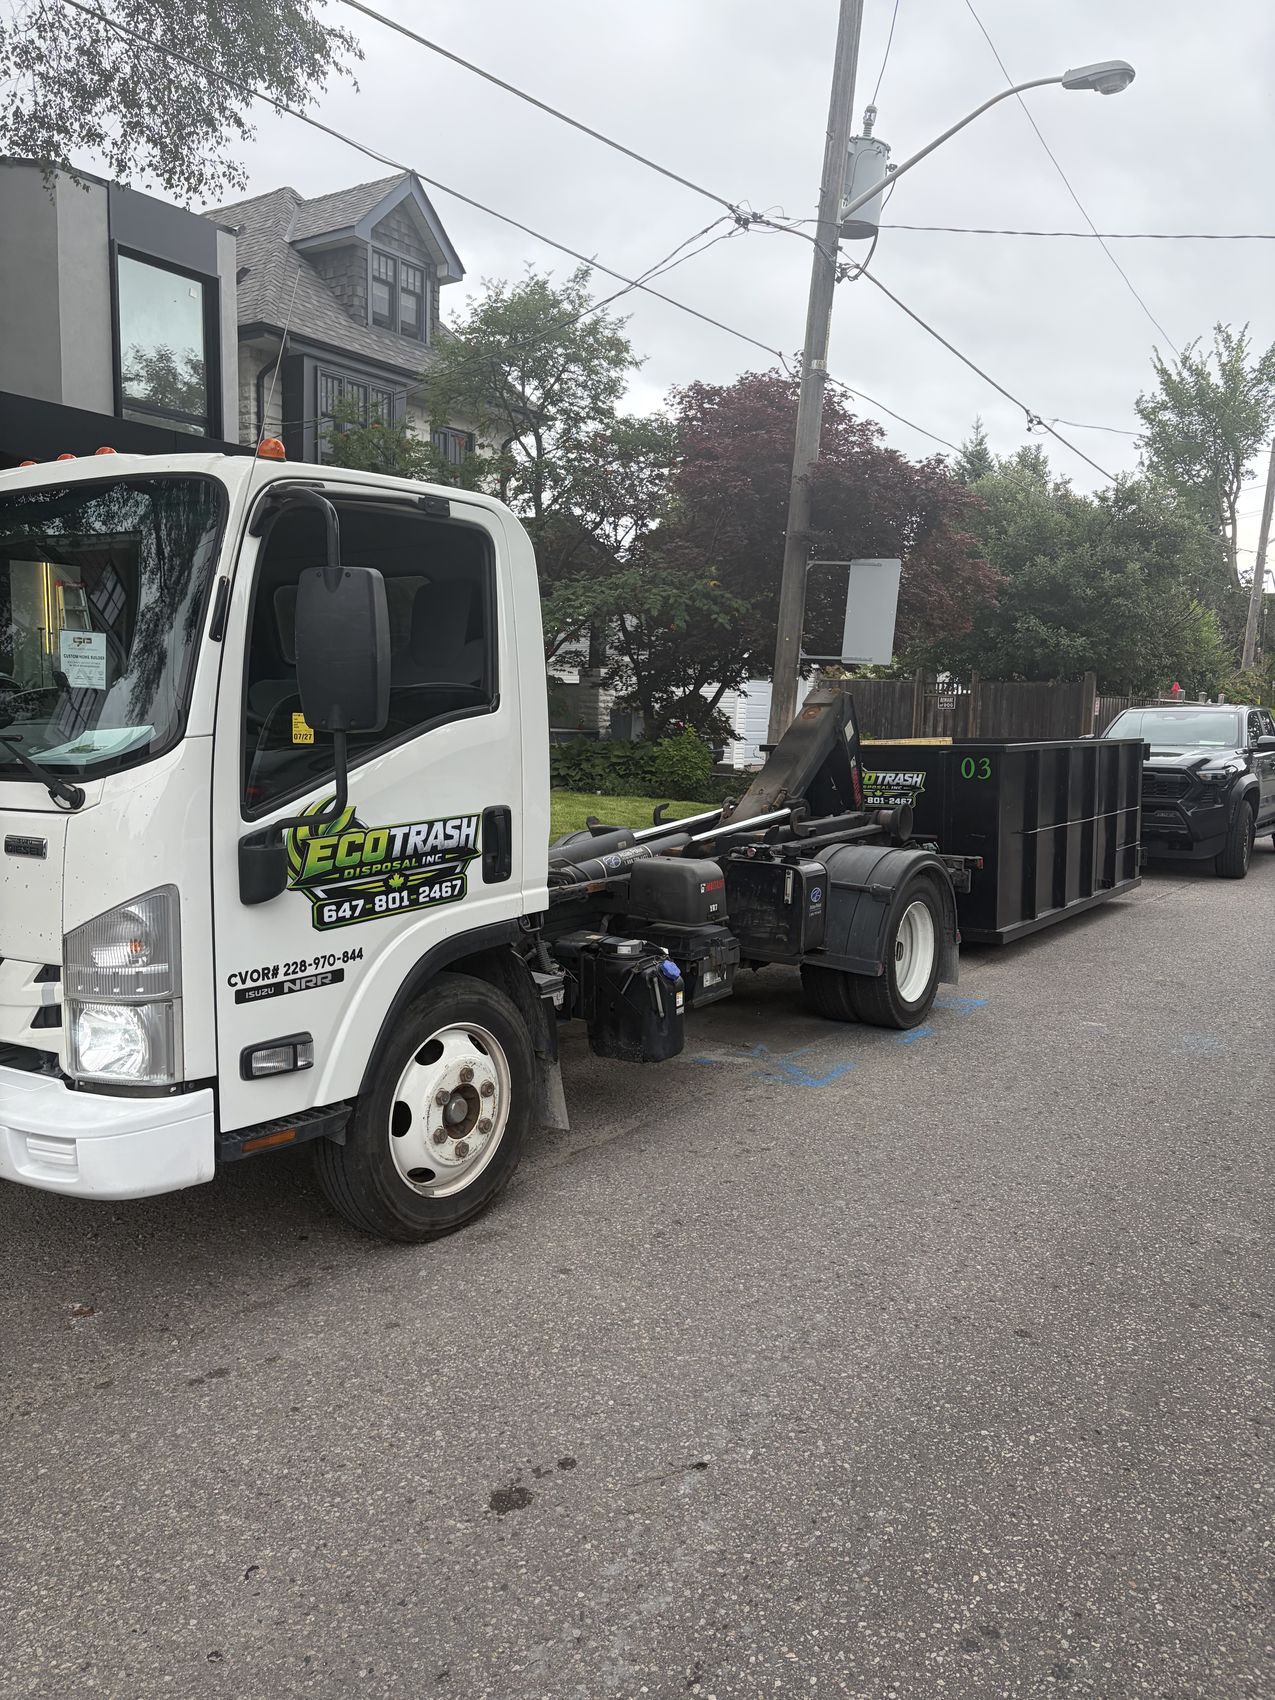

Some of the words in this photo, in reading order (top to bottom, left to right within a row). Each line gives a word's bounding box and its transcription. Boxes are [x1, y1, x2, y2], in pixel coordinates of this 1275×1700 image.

[293, 733, 313, 741] 07/27
[863, 772, 923, 788] OTRASH
[961, 757, 992, 780] 03
[301, 815, 478, 879] ECOTRASH
[343, 859, 419, 879] DISPOSAL
[421, 853, 443, 865] INC
[323, 879, 462, 923] 647-801-2467
[227, 964, 280, 988] CVOR#
[283, 947, 364, 977] 228-970-844
[245, 986, 275, 999] ISUZU
[283, 972, 333, 993] NRR
